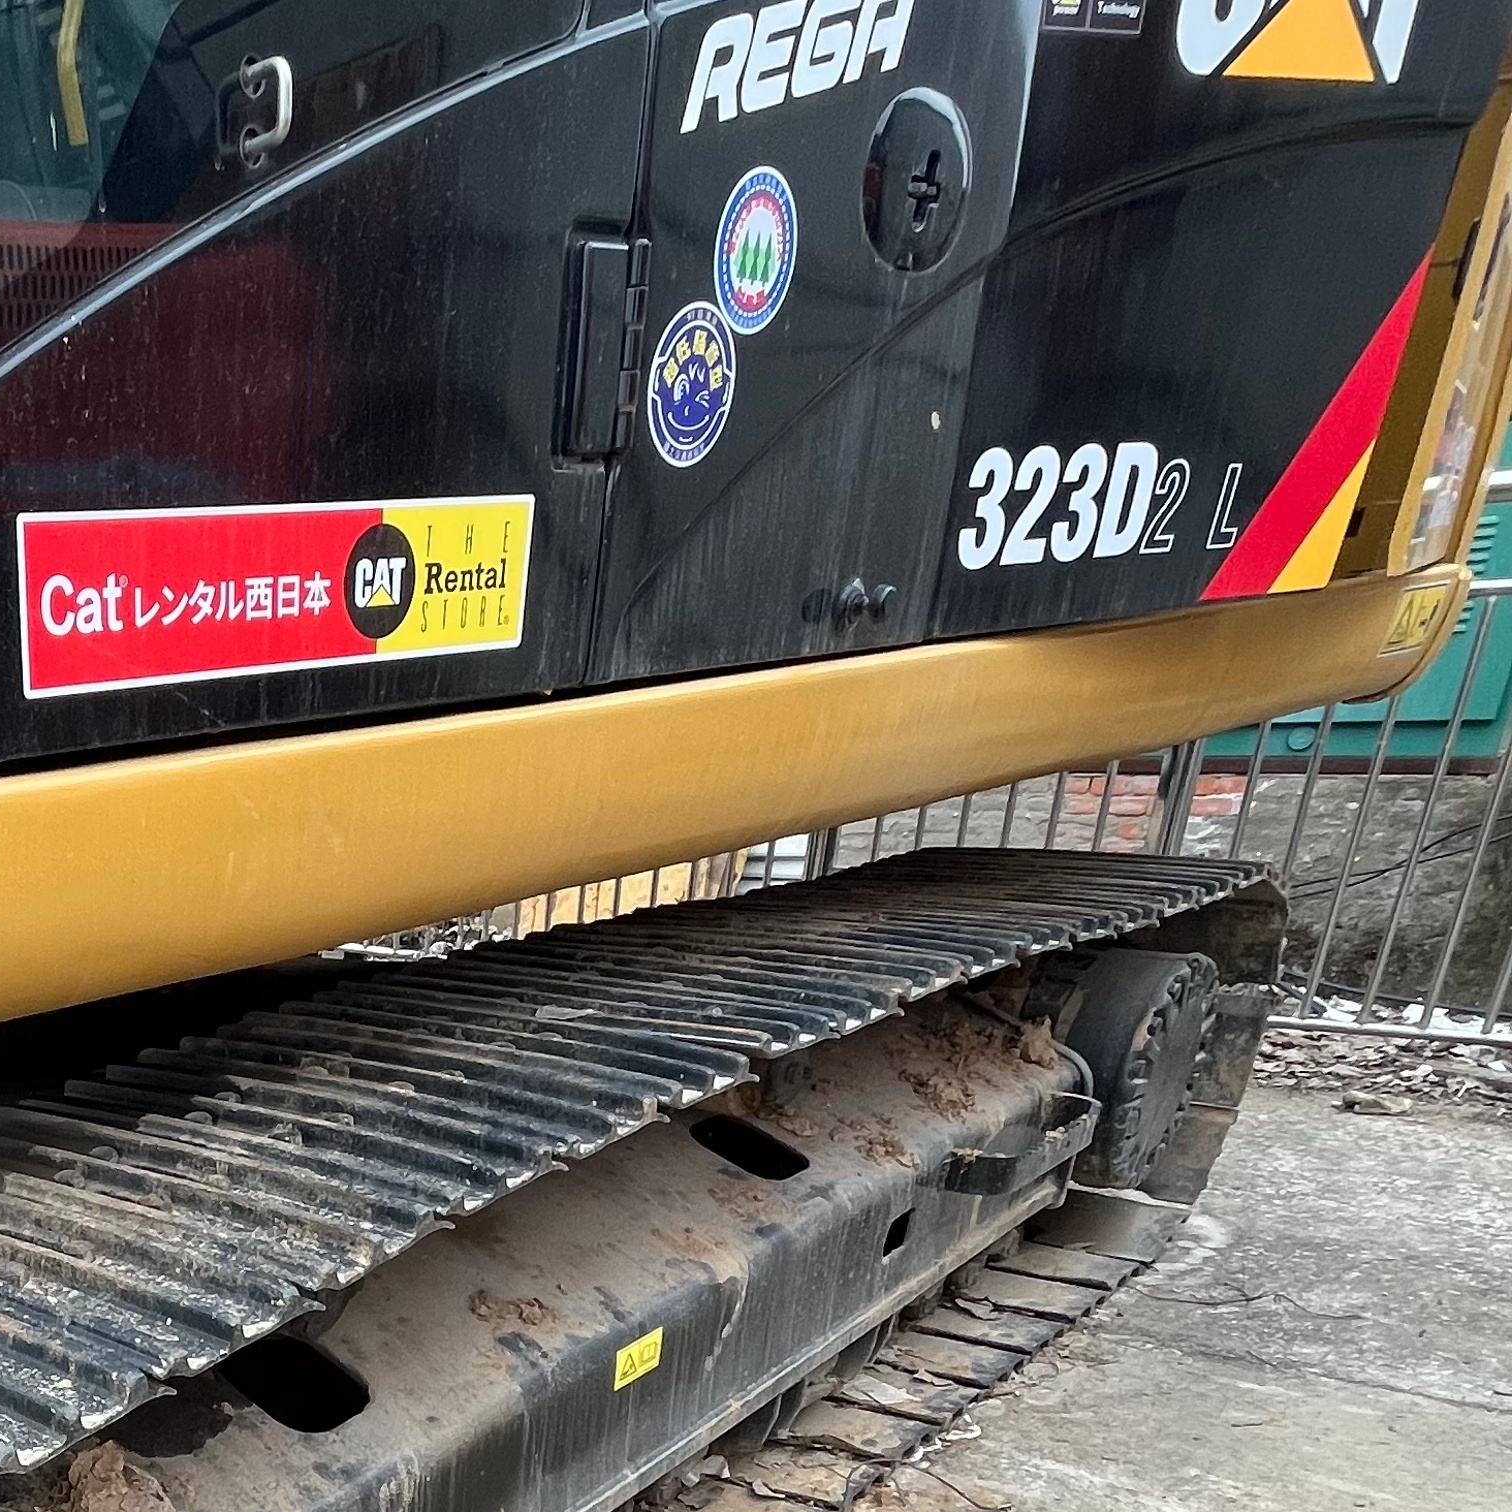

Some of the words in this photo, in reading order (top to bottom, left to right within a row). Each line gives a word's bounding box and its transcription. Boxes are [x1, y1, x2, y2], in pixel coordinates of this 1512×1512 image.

[1205, 462, 1244, 550] L
[425, 521, 511, 558] THE
[133, 570, 333, 629] レンタル西日本
[354, 556, 407, 609] CAT
[423, 558, 507, 595] Rental
